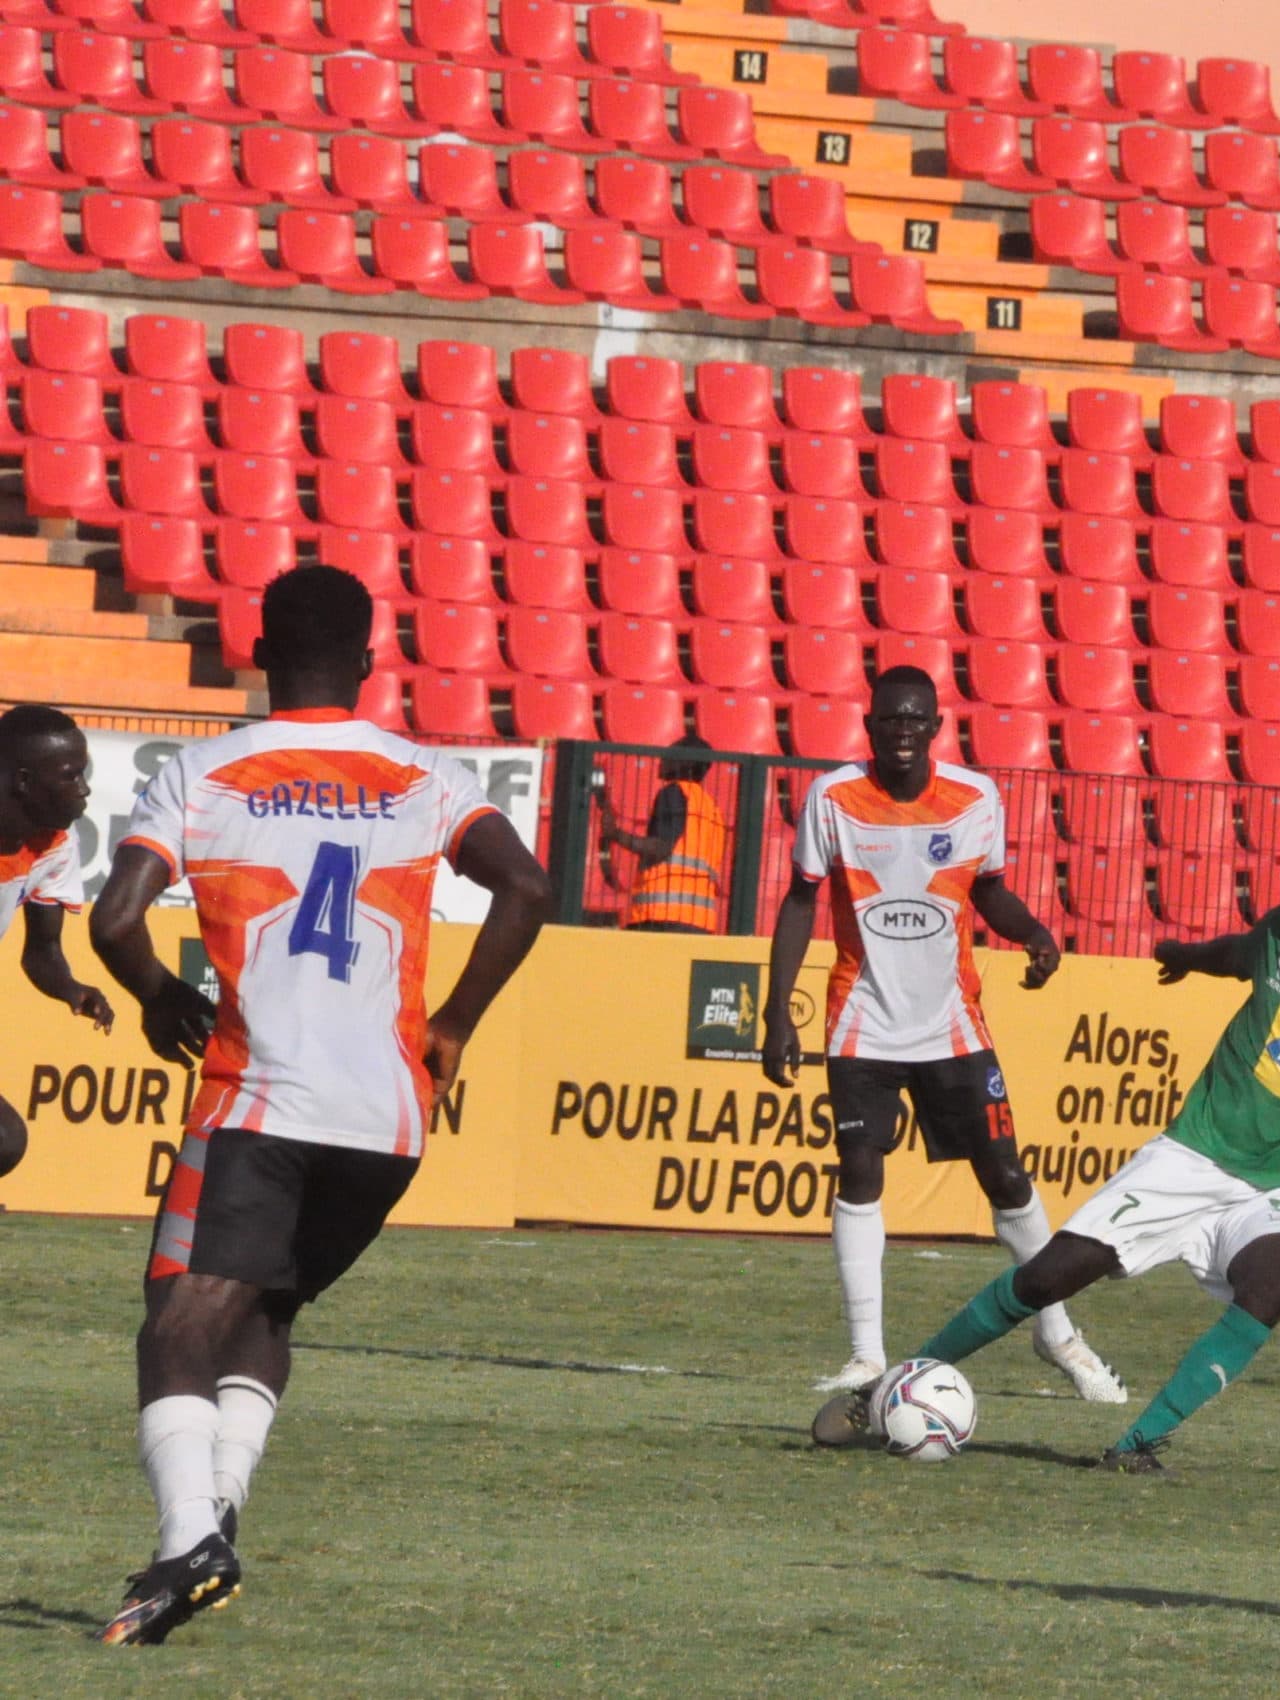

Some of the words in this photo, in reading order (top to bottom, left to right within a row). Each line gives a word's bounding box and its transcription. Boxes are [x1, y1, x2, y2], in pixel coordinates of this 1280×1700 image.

[741, 53, 761, 80] 14
[824, 135, 846, 161] 13
[910, 223, 932, 251] 12
[996, 301, 1015, 328] 11
[247, 780, 396, 820] GAZELLE
[288, 840, 361, 984] 4
[883, 913, 926, 927] MTN
[710, 988, 736, 1004] MTN
[703, 1004, 739, 1027] Elite
[1064, 1012, 1178, 1077] Alors,
[27, 1064, 170, 1125] POUR
[1056, 1085, 1104, 1124] on
[1114, 1071, 1182, 1126] fait
[551, 1081, 678, 1140] POUR
[687, 1088, 739, 1144] LA
[985, 1103, 1015, 1140] 15
[653, 1157, 719, 1214] DU
[1109, 1193, 1141, 1224] 7
